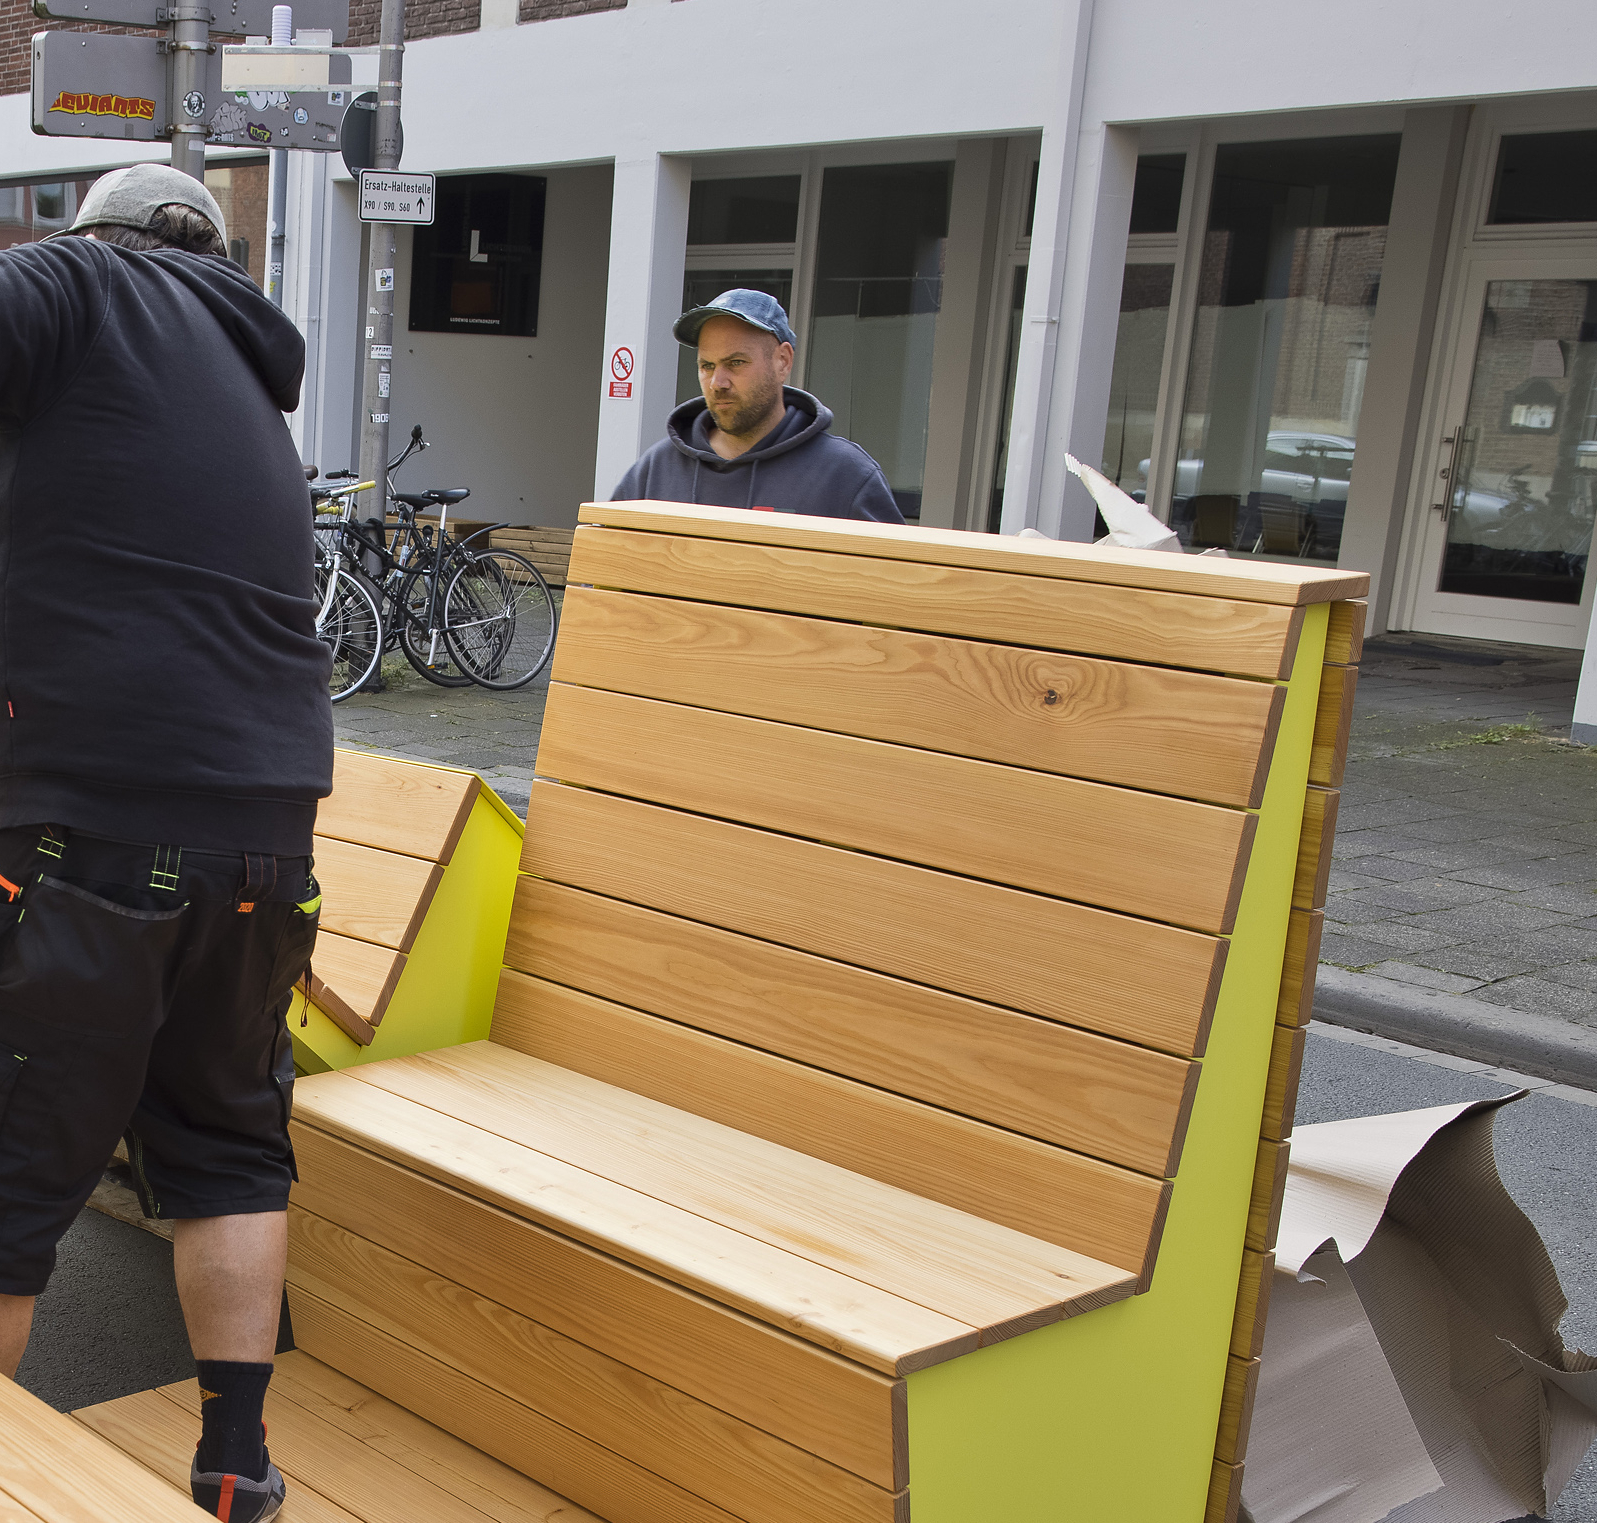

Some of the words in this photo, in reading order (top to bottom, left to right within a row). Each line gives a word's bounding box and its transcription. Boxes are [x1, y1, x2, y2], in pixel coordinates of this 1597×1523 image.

[364, 178, 431, 194] Ersatz-Haltestelle
[364, 200, 375, 210] X90
[399, 203, 410, 212] S60
